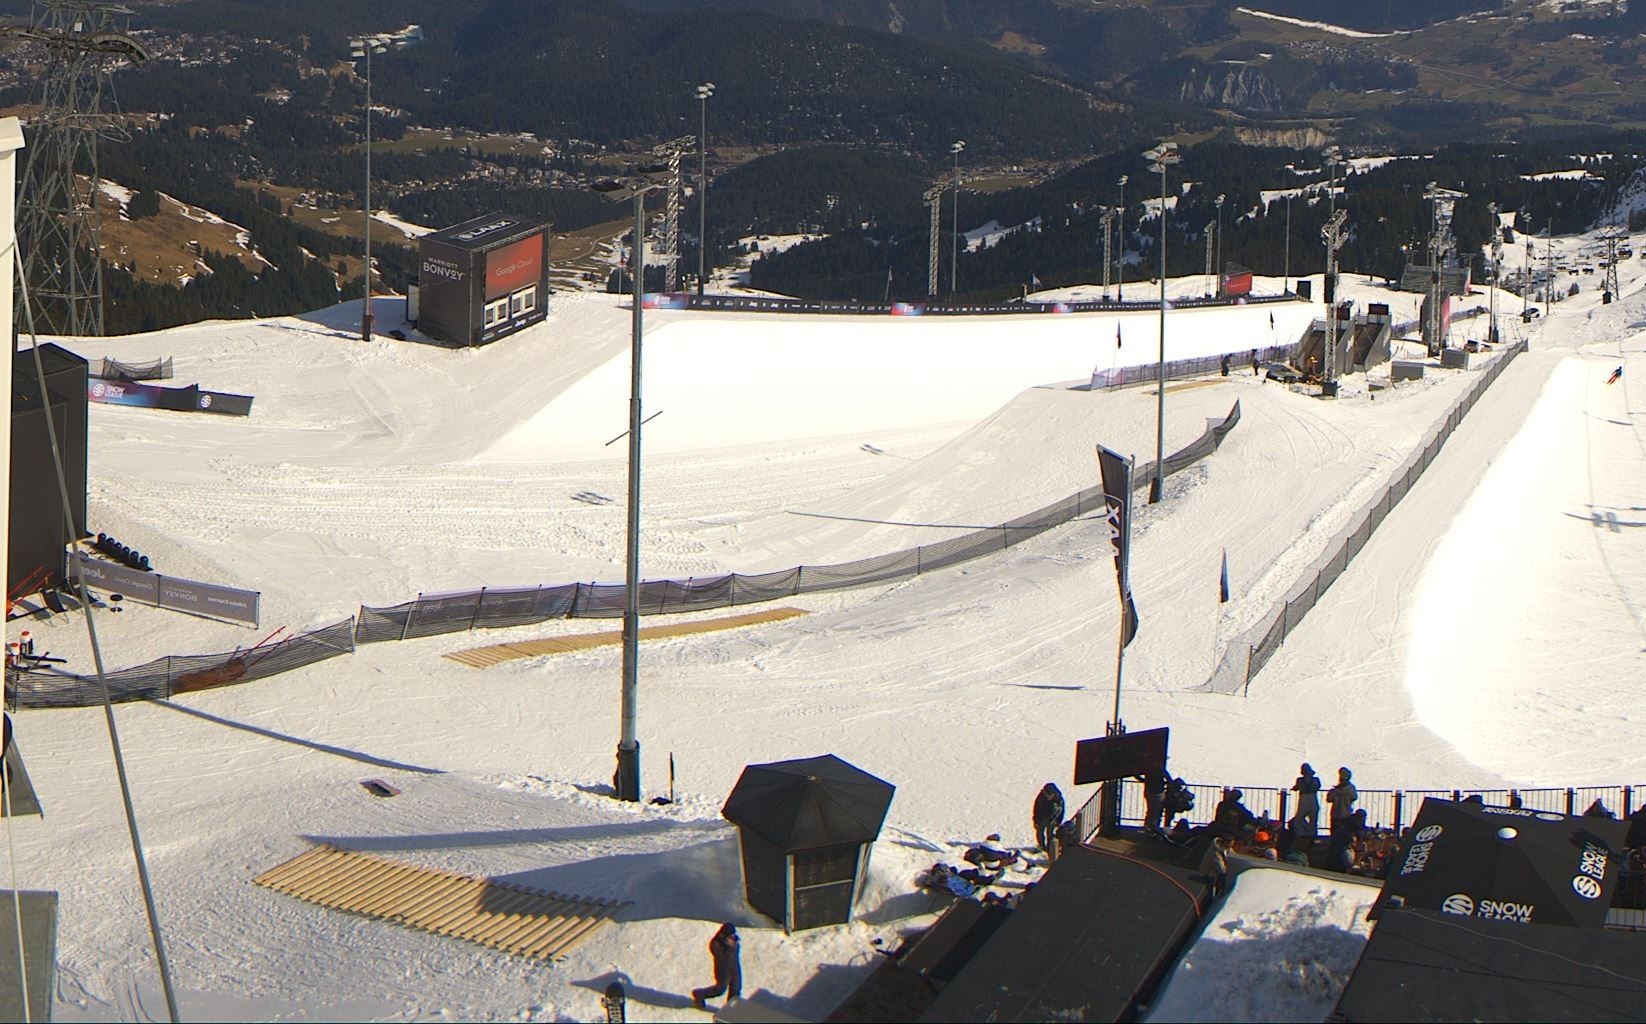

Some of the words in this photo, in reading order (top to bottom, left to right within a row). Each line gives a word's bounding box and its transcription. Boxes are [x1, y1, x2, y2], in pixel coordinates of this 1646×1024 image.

[423, 262, 464, 281] BONVOY
[428, 257, 459, 269] MARRIOTT
[1412, 842, 1434, 872] SNOW
[1478, 899, 1535, 918] SNOW
